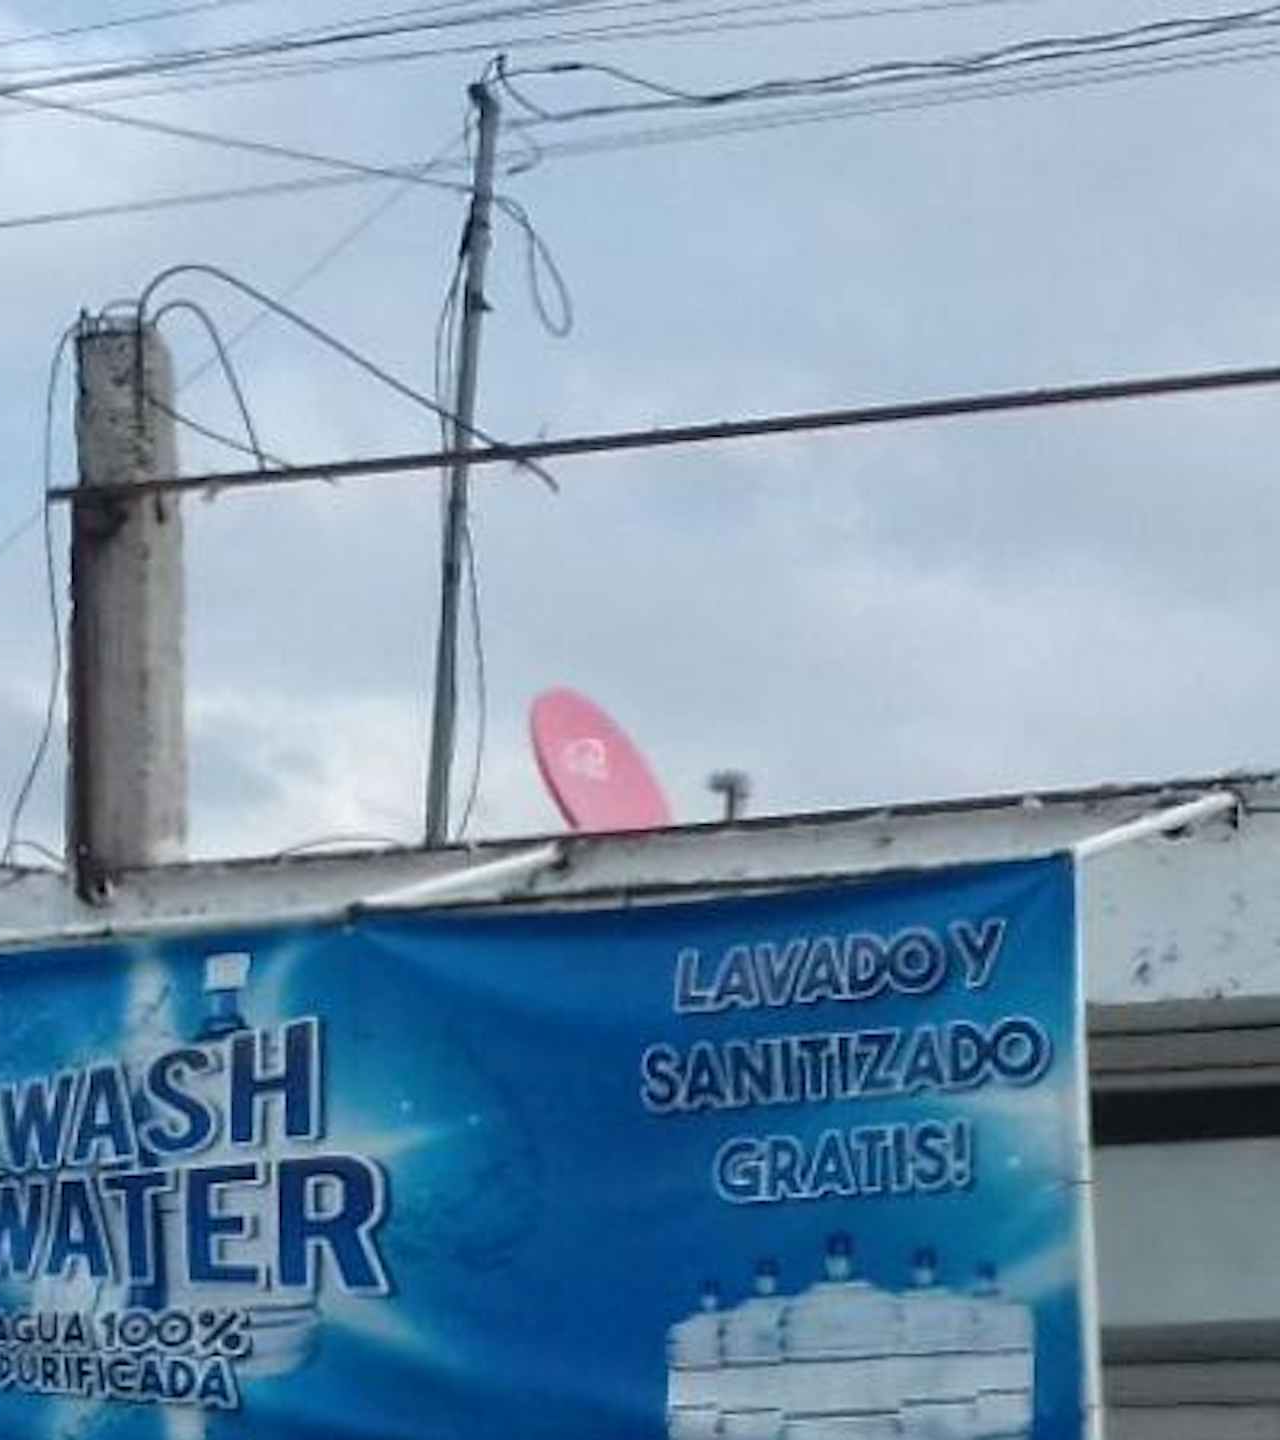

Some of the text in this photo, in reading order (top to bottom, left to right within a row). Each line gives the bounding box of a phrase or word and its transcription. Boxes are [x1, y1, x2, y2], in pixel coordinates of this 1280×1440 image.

[675, 918, 1006, 1012] LAVADO Y
[0, 1017, 324, 1170] WASH
[642, 1016, 1050, 1110] SANITIZADO
[712, 1120, 977, 1203] GRATIS!
[97, 1308, 250, 1356] 100%
